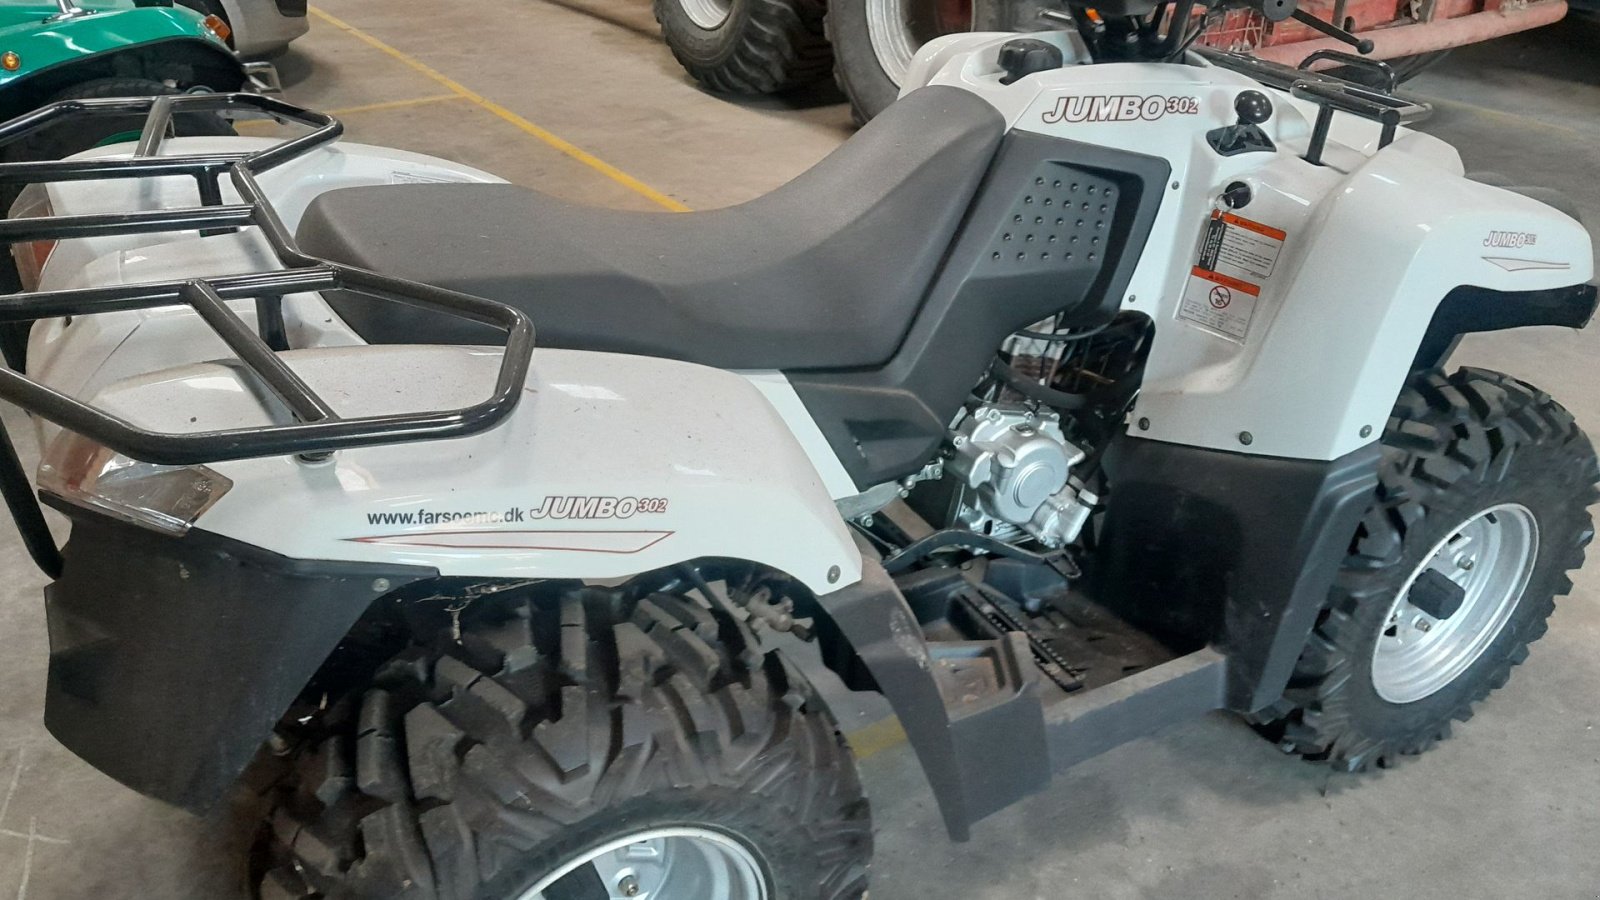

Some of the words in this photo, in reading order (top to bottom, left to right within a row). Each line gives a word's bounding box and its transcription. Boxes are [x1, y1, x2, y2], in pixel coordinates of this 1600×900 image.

[1042, 95, 1166, 124] JUMBO
[1166, 96, 1199, 114] 302
[1483, 230, 1525, 248] JUMBO
[530, 496, 638, 519] JUMBO
[637, 498, 668, 513] 302
